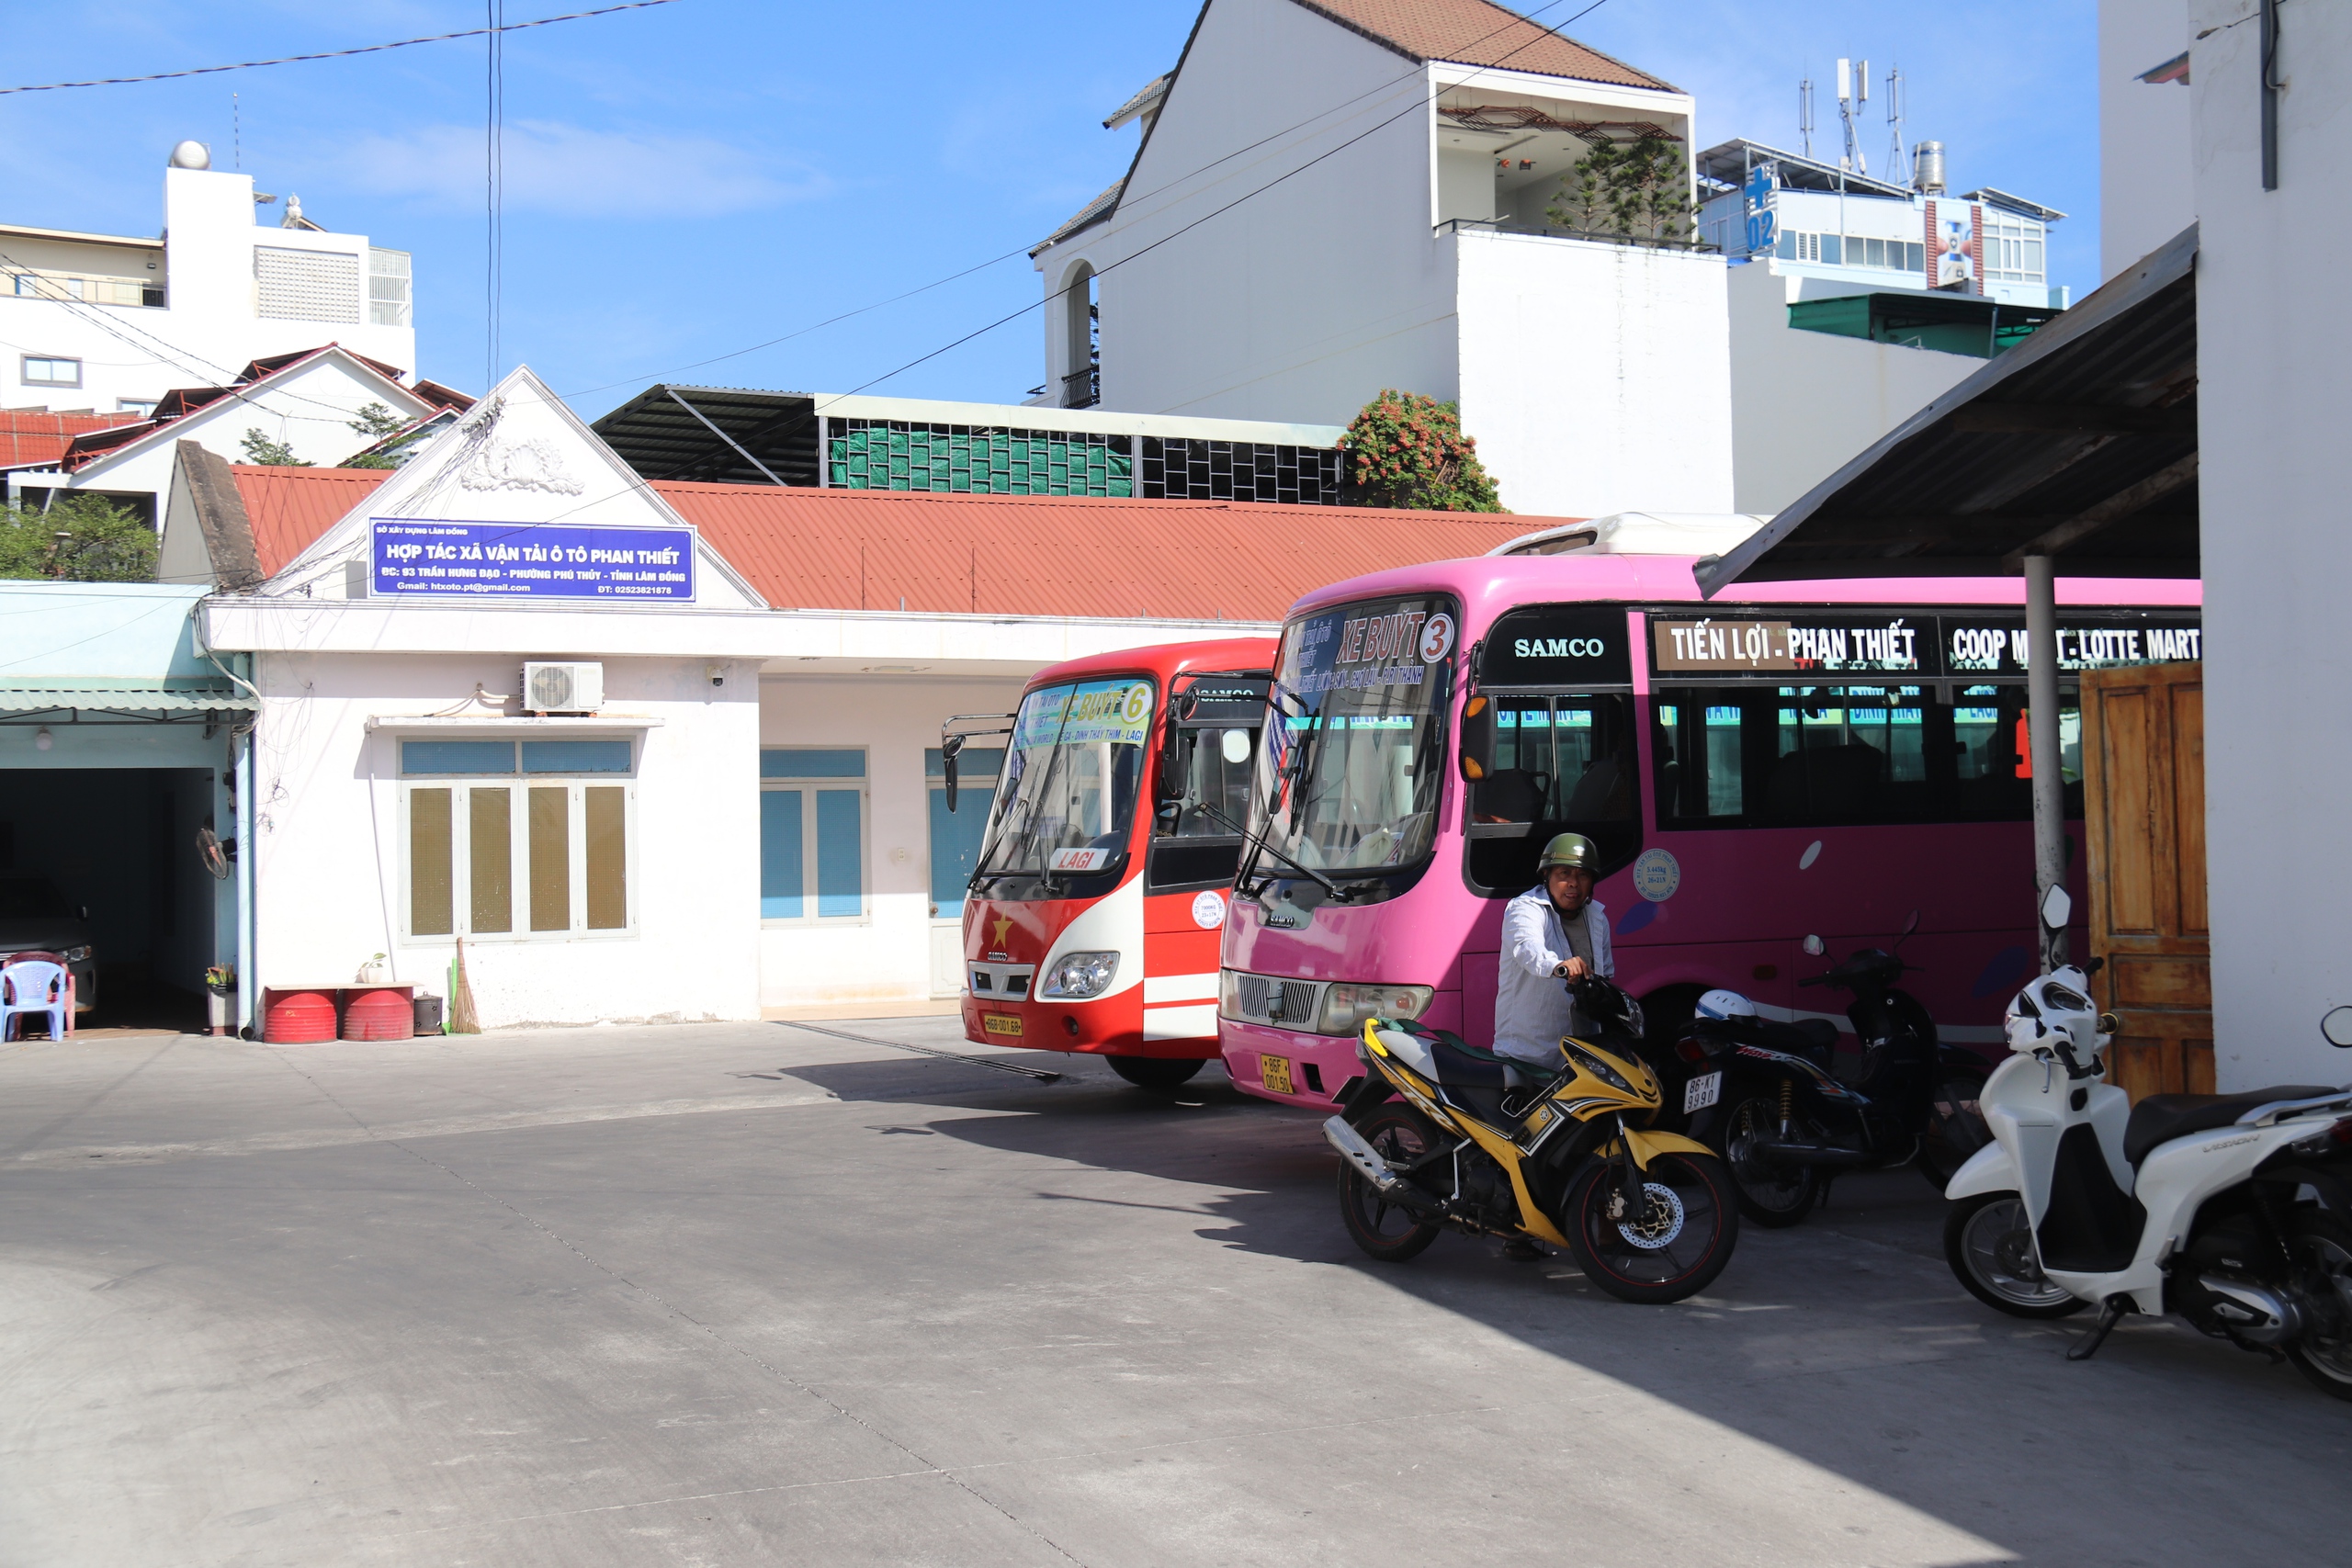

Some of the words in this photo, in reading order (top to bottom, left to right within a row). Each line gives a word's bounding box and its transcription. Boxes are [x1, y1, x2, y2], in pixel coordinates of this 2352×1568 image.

[1747, 210, 1774, 252] 02
[387, 544, 422, 563] HỢP
[425, 542, 457, 559] TÁC
[459, 542, 482, 560] XÃ
[485, 544, 519, 565] VẬN
[523, 544, 547, 561] TẢI
[550, 545, 563, 562] Ô
[566, 546, 588, 563] TÔ
[591, 549, 634, 564] PHAN
[637, 547, 680, 565] THIẾT
[402, 568, 415, 576] 93
[447, 568, 476, 578] HƯNG
[479, 569, 500, 580] ĐẠO
[553, 570, 574, 580] PHÚ
[635, 570, 656, 581] LÂM
[397, 581, 428, 591] Gmail:
[431, 582, 530, 593] htxoto.pt@gmail.com
[615, 585, 673, 595] 02523821878
[1336, 618, 1367, 663] XE
[1426, 619, 1446, 657] 3
[1515, 637, 1604, 658] SAMCO
[1671, 618, 1725, 660] TIẾN
[1732, 624, 1770, 666] LỢI
[1787, 628, 1847, 660] PHAN
[1851, 619, 1915, 660] THIẾT
[1953, 628, 2006, 660] COOP
[2011, 628, 2065, 660] MT
[2079, 629, 2141, 660] LOTTE
[2146, 628, 2199, 660] MART
[1056, 694, 1079, 724] XE
[1127, 687, 1146, 718] 6
[1125, 730, 1144, 741] LAGI
[1057, 852, 1095, 869] LAGI
[1690, 1075, 1715, 1094] 86-K1
[1688, 1090, 1713, 1109] 9990
